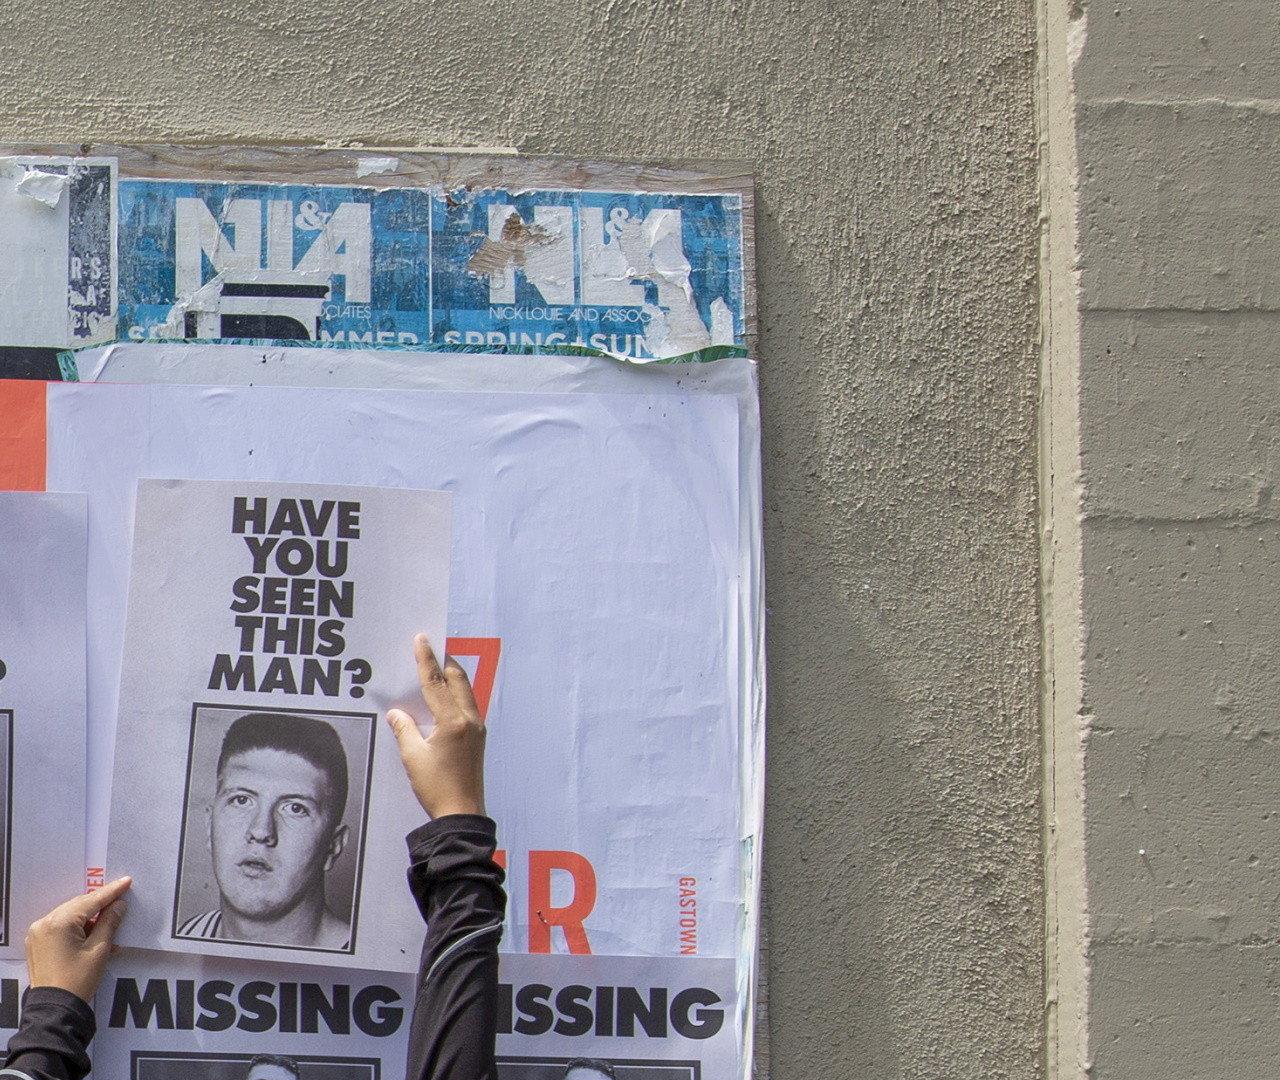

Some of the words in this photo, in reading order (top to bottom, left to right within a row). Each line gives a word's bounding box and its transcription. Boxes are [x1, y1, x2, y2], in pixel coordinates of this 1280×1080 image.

[489, 307, 526, 321] NICK
[527, 307, 563, 321] LOUIE
[568, 308, 599, 321] AND
[603, 308, 653, 322] ASSOC
[233, 497, 360, 539] HAVE
[244, 537, 348, 577] YOU
[230, 577, 354, 618] SEEN
[235, 616, 345, 656] THIS
[208, 654, 371, 698] MAN?
[86, 867, 104, 894] EN
[678, 876, 698, 956] GASTOWN
[107, 977, 405, 1037] MISSING
[496, 983, 725, 1040] ISSING
